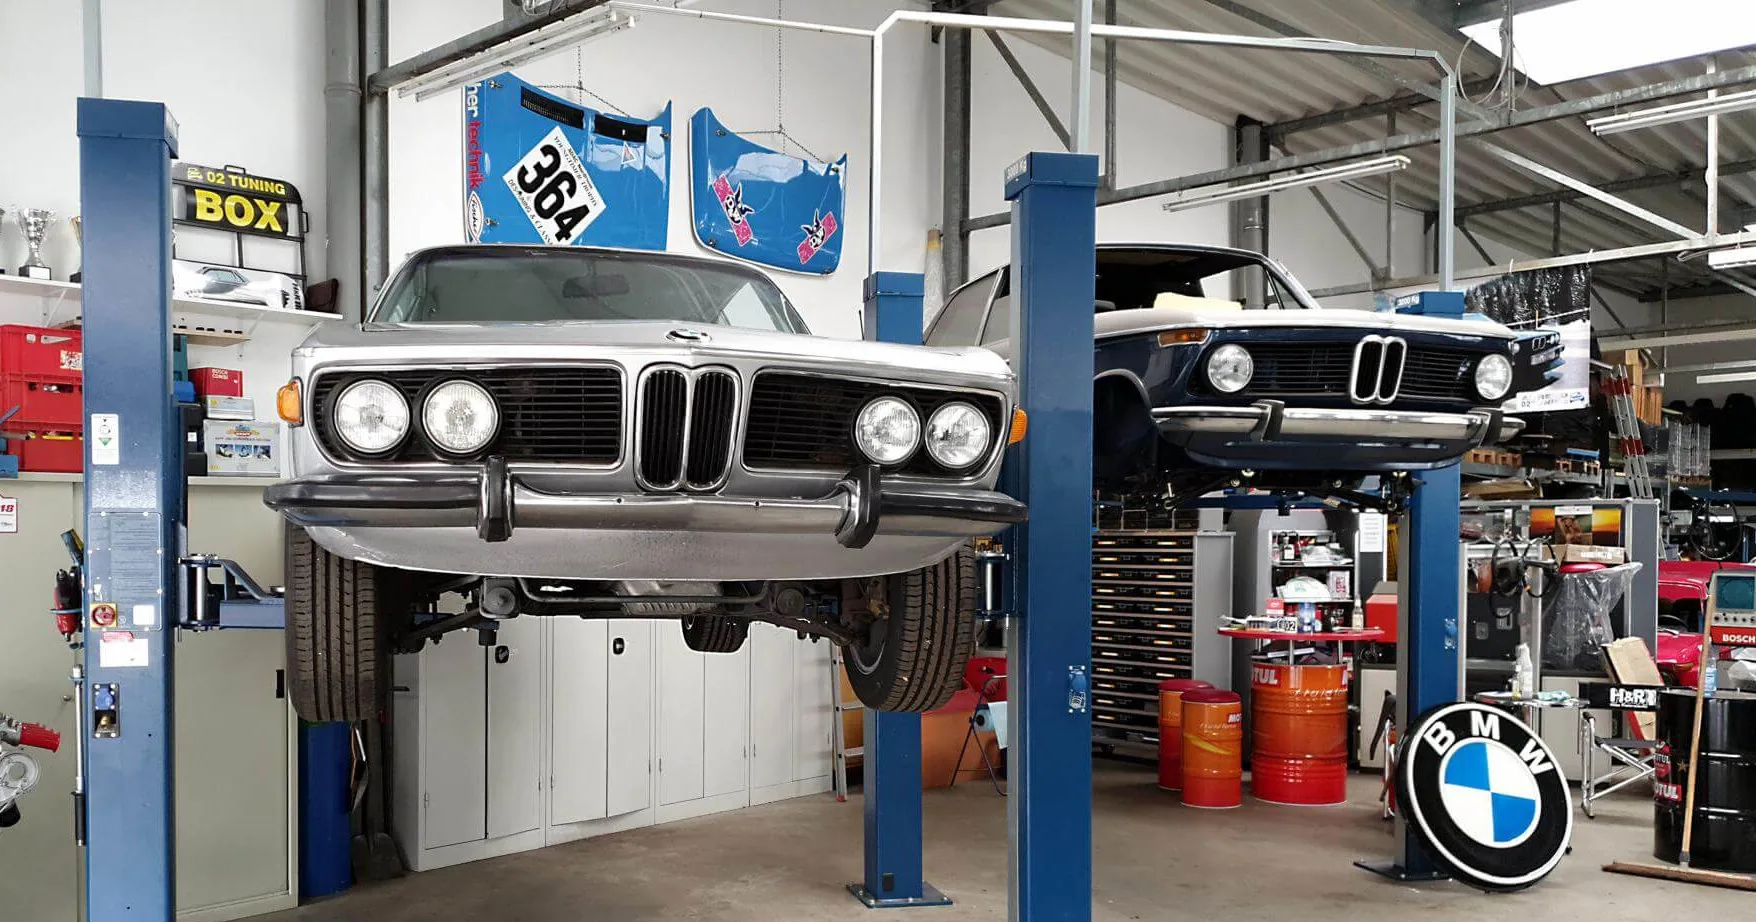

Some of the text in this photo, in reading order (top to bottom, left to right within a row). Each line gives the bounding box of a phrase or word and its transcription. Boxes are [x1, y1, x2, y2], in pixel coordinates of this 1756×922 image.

[467, 120, 485, 190] technik
[207, 171, 226, 185] 02
[228, 175, 286, 196] TUNING
[517, 144, 590, 242] 364
[194, 188, 283, 232] BOX
[1722, 633, 1756, 644] BOSCH
[1609, 687, 1646, 704] H&R
[1423, 711, 1554, 776] BMW
[1654, 782, 1679, 800] OTUL
